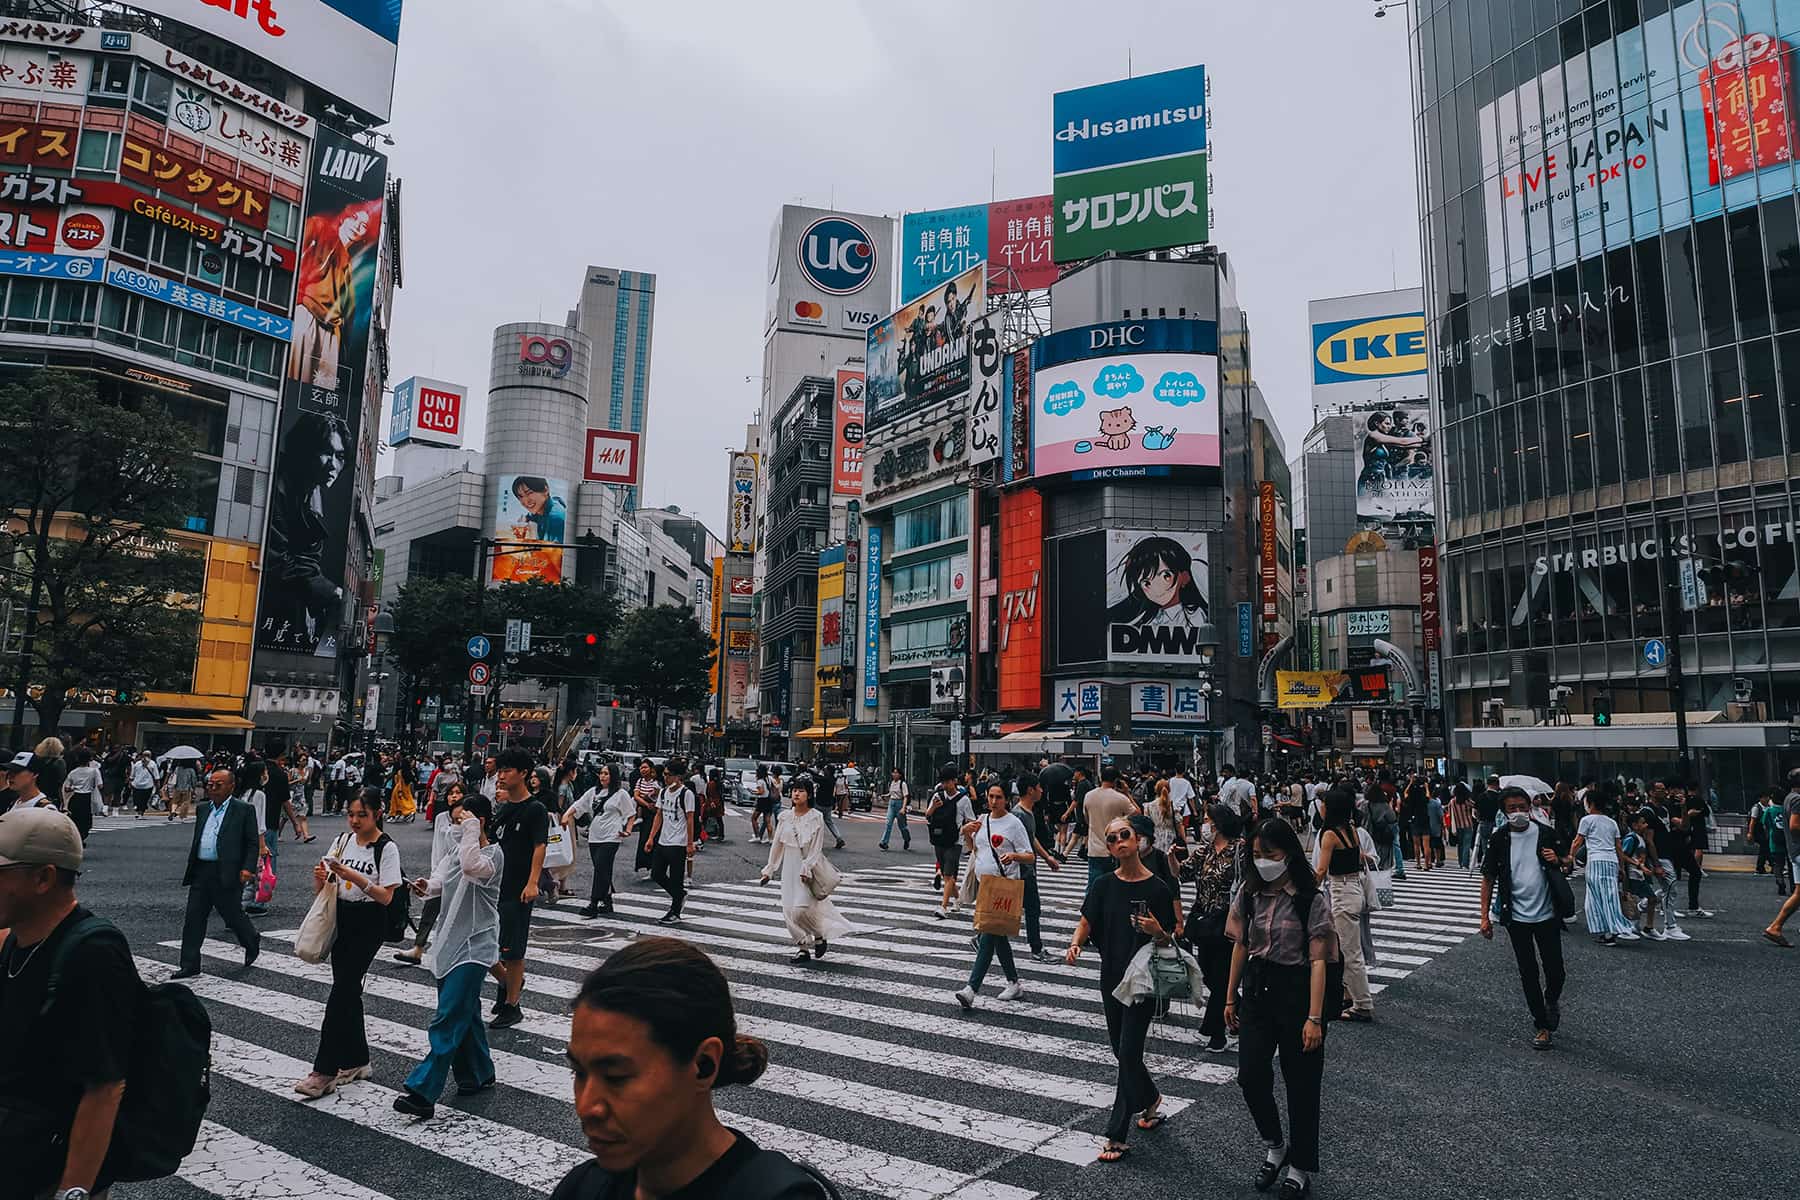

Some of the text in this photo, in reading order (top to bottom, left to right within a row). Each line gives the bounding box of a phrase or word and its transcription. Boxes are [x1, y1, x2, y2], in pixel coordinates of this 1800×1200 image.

[1056, 105, 1203, 142] Hisamitsu
[1509, 130, 1527, 144] Fre
[1528, 115, 1556, 135] Toist
[1558, 88, 1615, 120] Inormtion
[1562, 102, 1616, 131] Lnguges
[1725, 74, 1770, 152] 御守
[219, 111, 302, 168] しゃぶ葉
[1503, 108, 1669, 199] LIVE JAPAN
[1, 174, 82, 205] ガスト
[123, 141, 264, 216] コンタクト
[1557, 182, 1586, 201] GUDE
[1062, 181, 1199, 233] サロンパス
[66, 228, 100, 241] ガスト
[221, 228, 284, 266] ガスト
[920, 225, 971, 253] 龍角散
[68, 261, 90, 276] 6F
[913, 250, 981, 277] ダイレクト
[115, 268, 289, 335] AEON 英会話 イーオン
[846, 310, 879, 324] VISA
[1090, 325, 1145, 349] DHC
[1331, 331, 1425, 363] IKE
[516, 333, 573, 379] 109
[920, 335, 968, 377] UNDAWN
[310, 388, 340, 408] 玄師
[972, 318, 1000, 456] もんじゃ
[424, 393, 454, 412] UNI
[422, 410, 455, 429] QLO
[598, 447, 626, 466] H&M
[1093, 467, 1146, 478] DHC Channel
[1263, 566, 1276, 615] 三千里
[1420, 556, 1437, 621] カラオケ
[1349, 623, 1390, 634] クリニック
[1060, 685, 1199, 713] 大盛 書店
[340, 858, 374, 876] ELLIS
